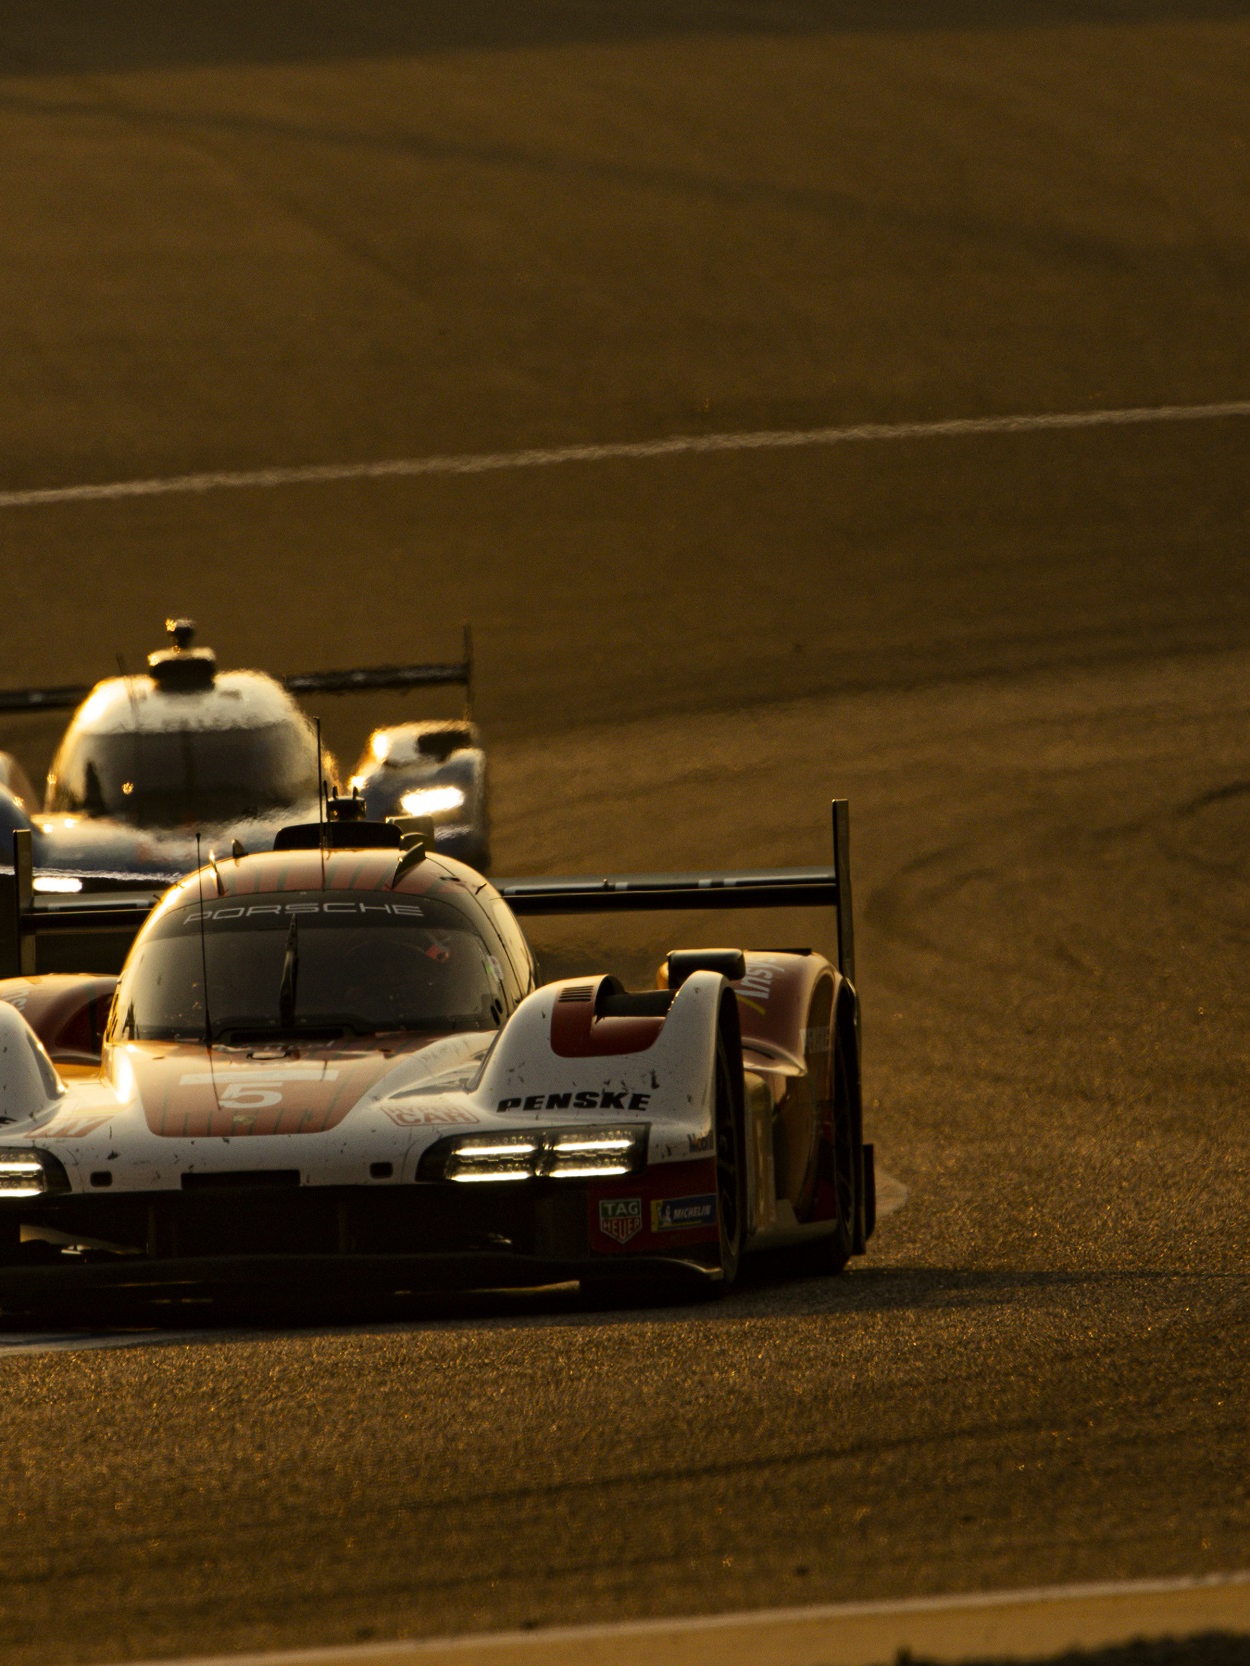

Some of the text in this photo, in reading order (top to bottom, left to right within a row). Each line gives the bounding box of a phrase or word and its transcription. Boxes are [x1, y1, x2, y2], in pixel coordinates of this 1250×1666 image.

[183, 902, 424, 925] PORSCHE
[218, 1082, 283, 1108] 5
[497, 1091, 651, 1113] PENSKE
[396, 1112, 471, 1123] CAR
[603, 1202, 639, 1216] TAG
[673, 1204, 711, 1219] MICHELIN
[602, 1218, 639, 1239] HEUER
